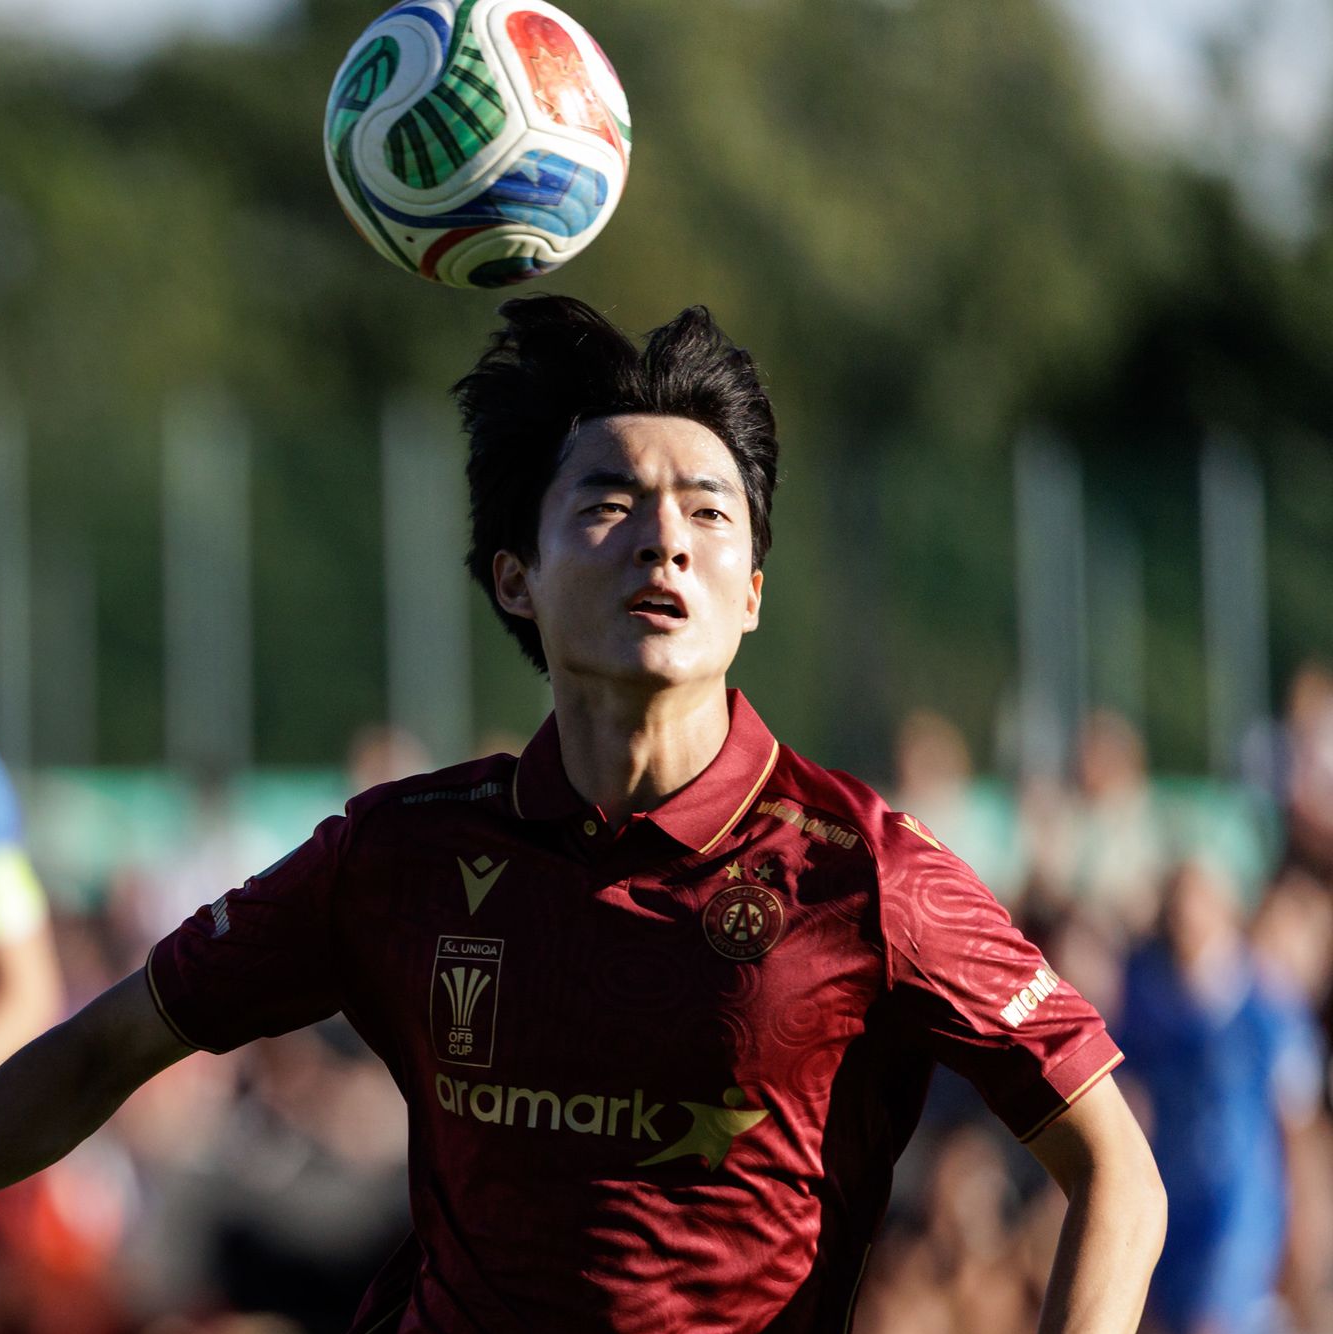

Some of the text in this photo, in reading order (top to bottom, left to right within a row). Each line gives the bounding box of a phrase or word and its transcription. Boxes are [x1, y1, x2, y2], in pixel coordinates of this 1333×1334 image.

[461, 943, 498, 955] UNIQA
[448, 1043, 473, 1056] CUP
[435, 1072, 665, 1142] aramark
